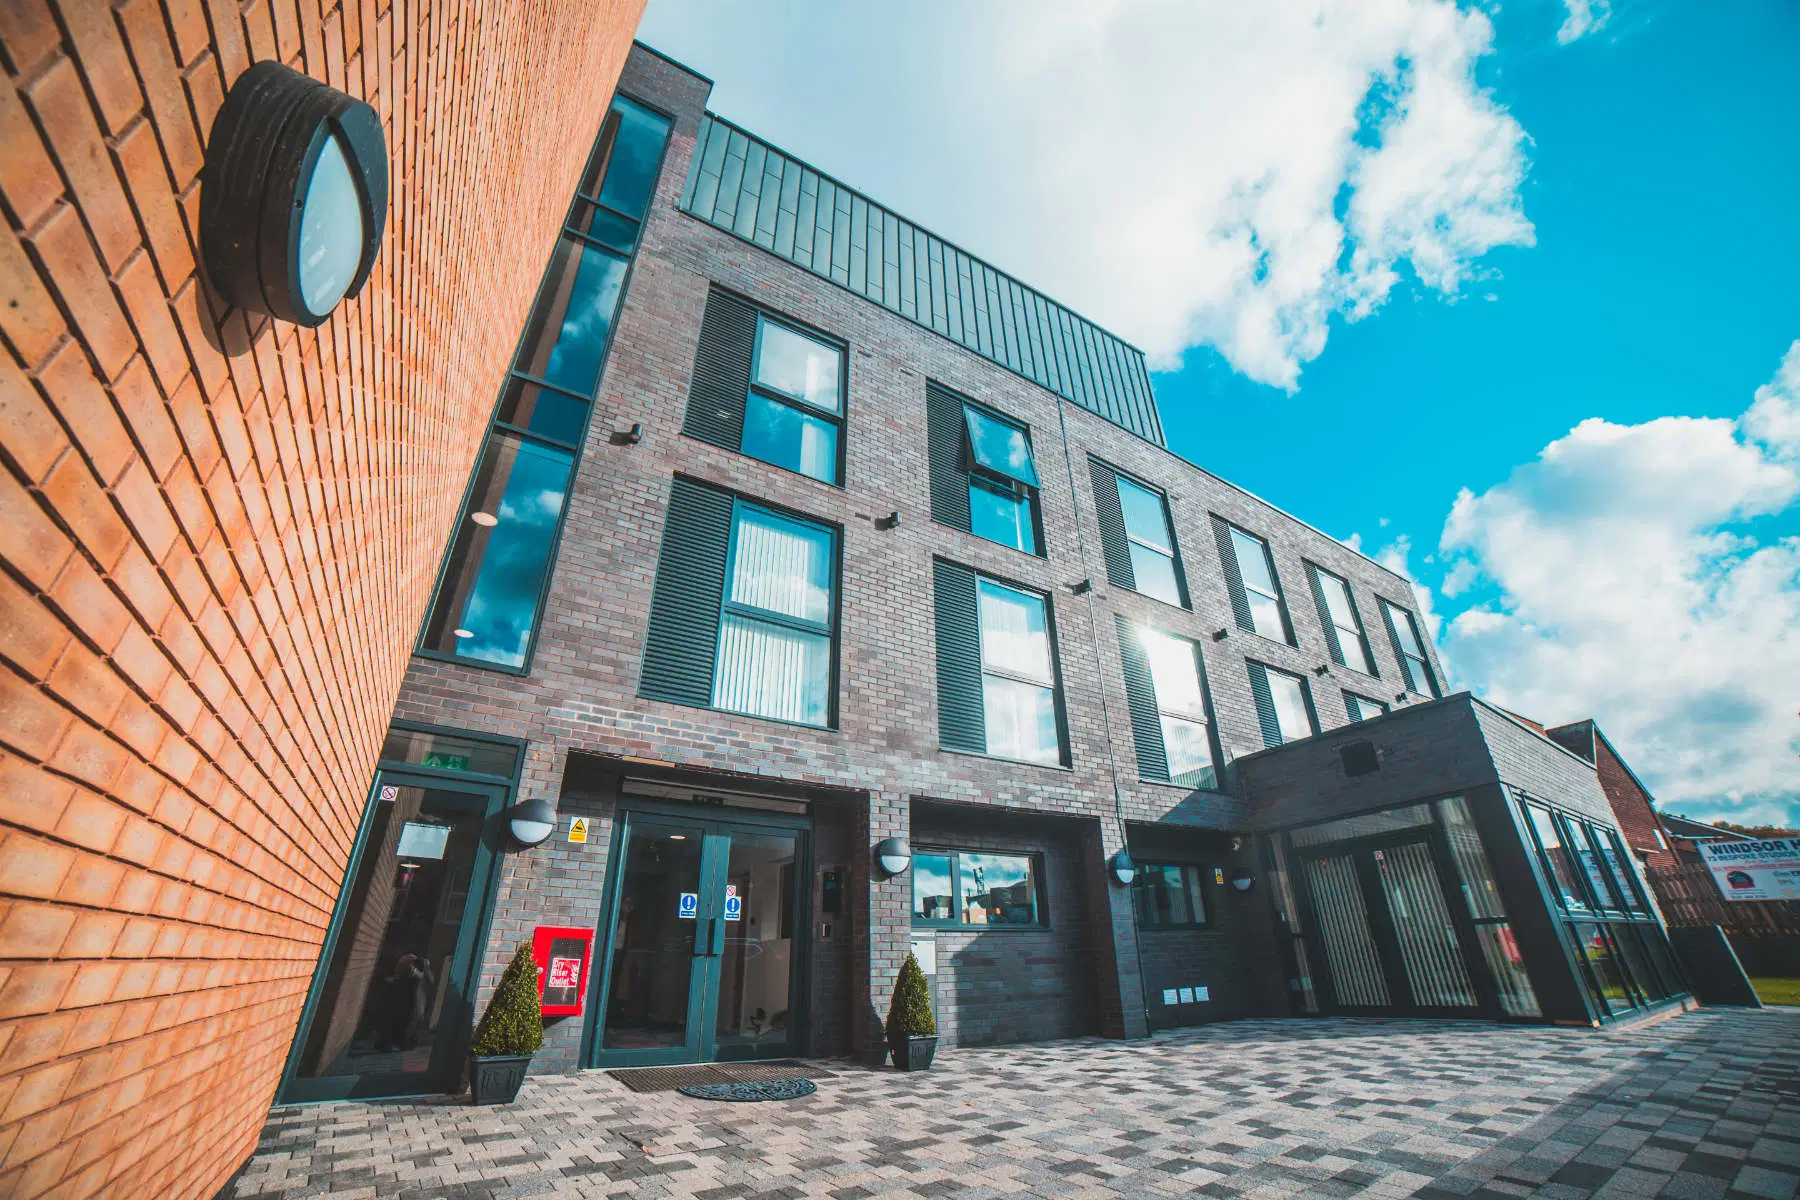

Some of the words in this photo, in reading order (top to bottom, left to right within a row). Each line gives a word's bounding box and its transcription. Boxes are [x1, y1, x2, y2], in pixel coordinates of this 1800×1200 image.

[1708, 841, 1788, 854] WINDSOR
[553, 959, 565, 970] Dry
[552, 968, 568, 976] Riser
